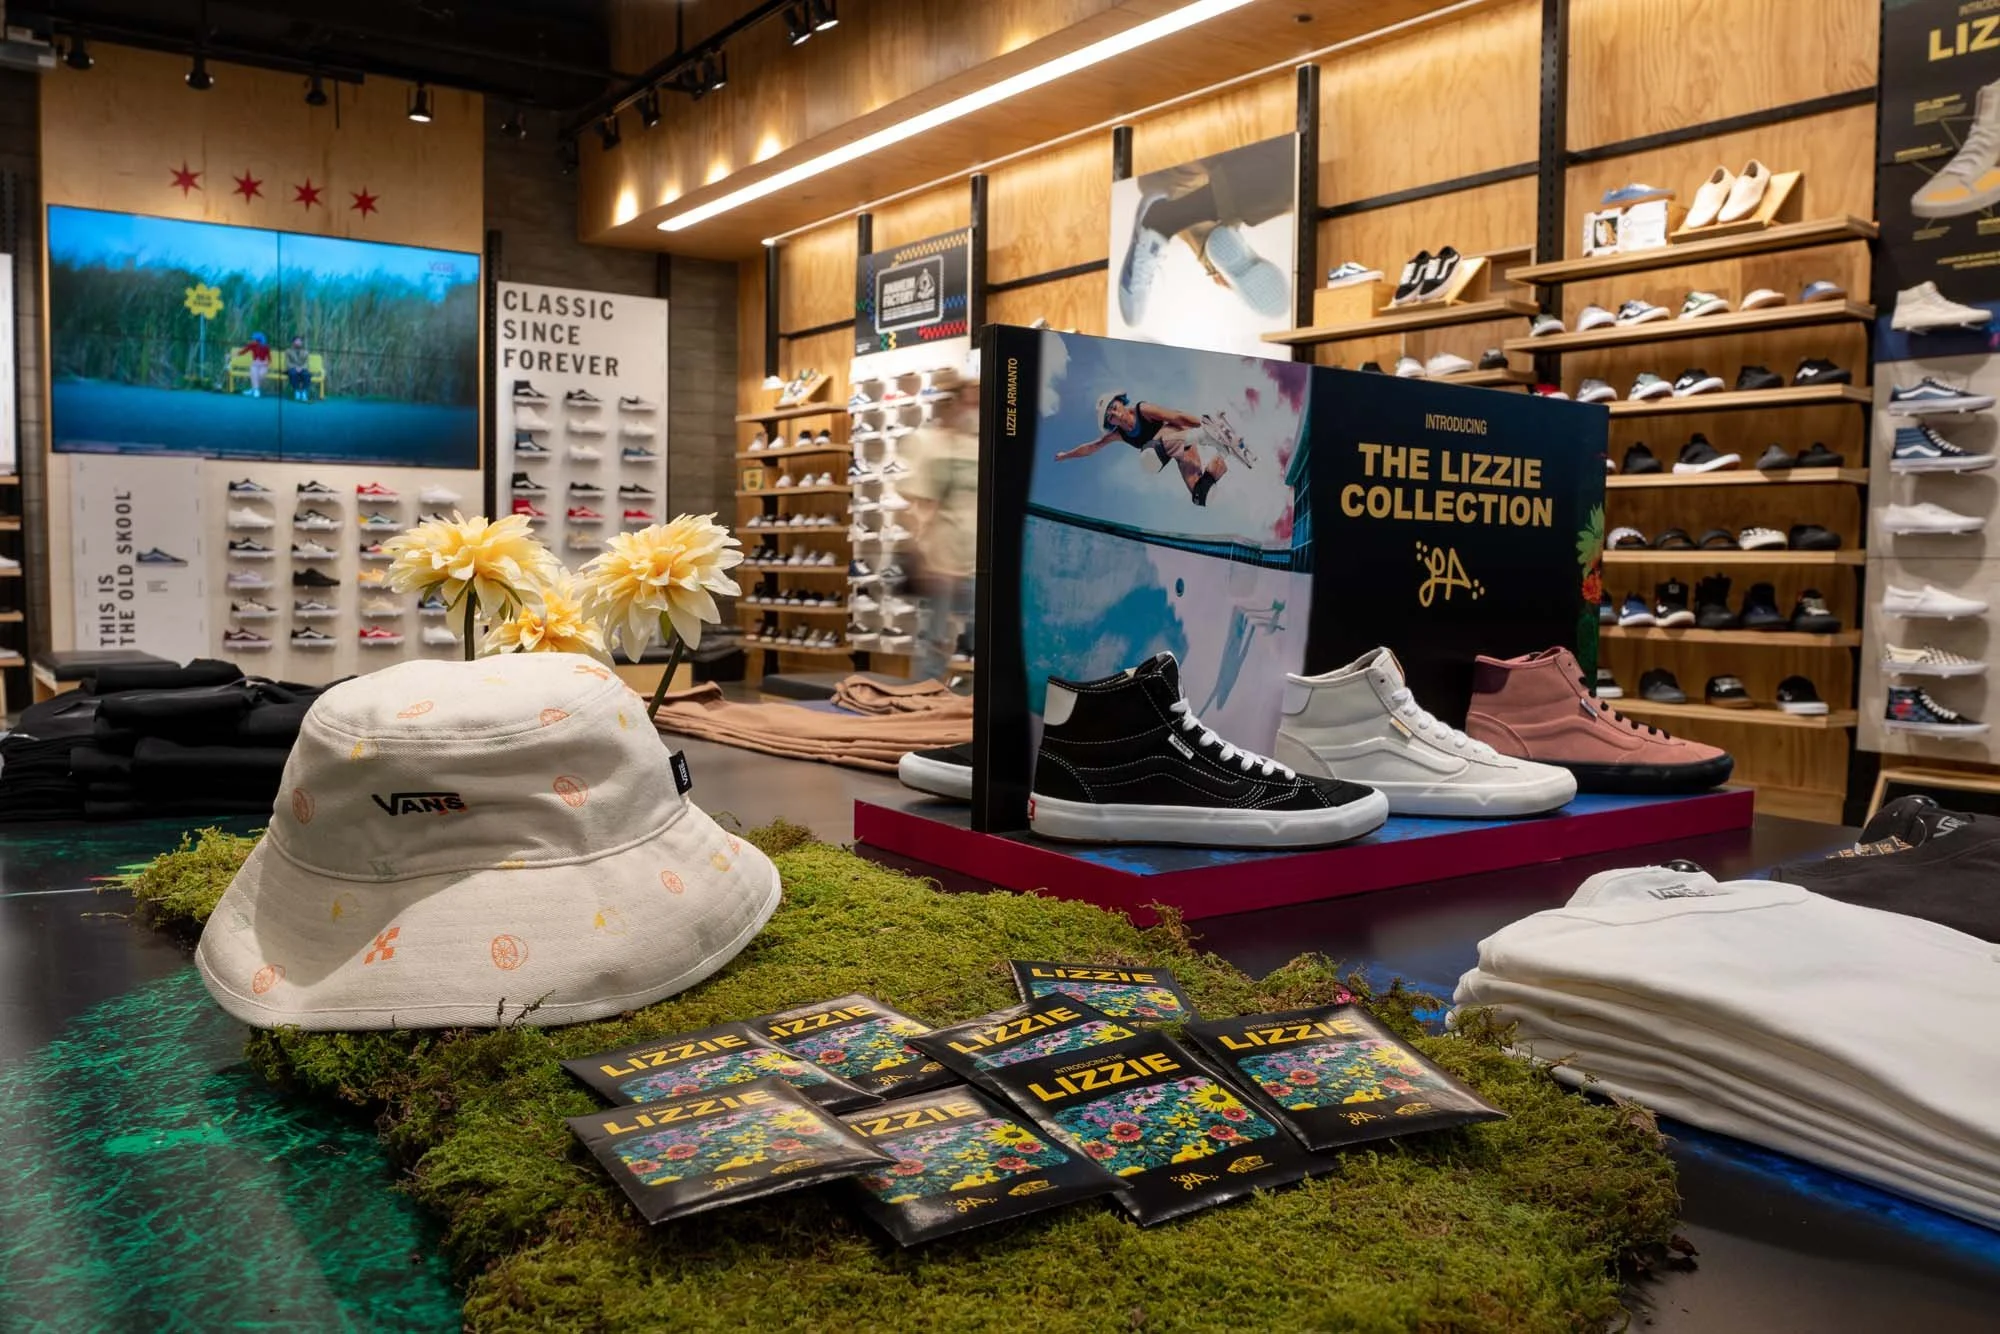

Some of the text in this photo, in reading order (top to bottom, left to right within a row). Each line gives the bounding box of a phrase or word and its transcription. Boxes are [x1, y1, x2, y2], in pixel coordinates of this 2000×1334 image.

[1929, 15, 2000, 61] LIZ
[503, 289, 614, 321] CLASSIC
[503, 319, 581, 345] SINCE
[504, 348, 619, 377] FOREVER
[1006, 358, 1018, 436] LIZZIE ARMANTO
[1425, 413, 1487, 435] INTRODUCING
[1358, 442, 1542, 489] THE LIZZIE
[1340, 483, 1553, 528] COLLECTION
[115, 491, 136, 646] THE OLD SKOOL
[97, 574, 116, 646] THIS IS
[679, 759, 689, 785] VANS
[372, 792, 465, 817] VANS
[1031, 968, 1157, 984] LIZZIE
[769, 1004, 878, 1040] IZZIE
[947, 1006, 1082, 1054] LIZZIE
[1218, 1018, 1367, 1050] LIZZIE
[600, 1034, 749, 1077] LIZZIE
[1055, 1053, 1126, 1075] INTRODUCING THE
[1027, 1052, 1181, 1102] LIZZIE
[603, 1090, 777, 1135] LIZZIE
